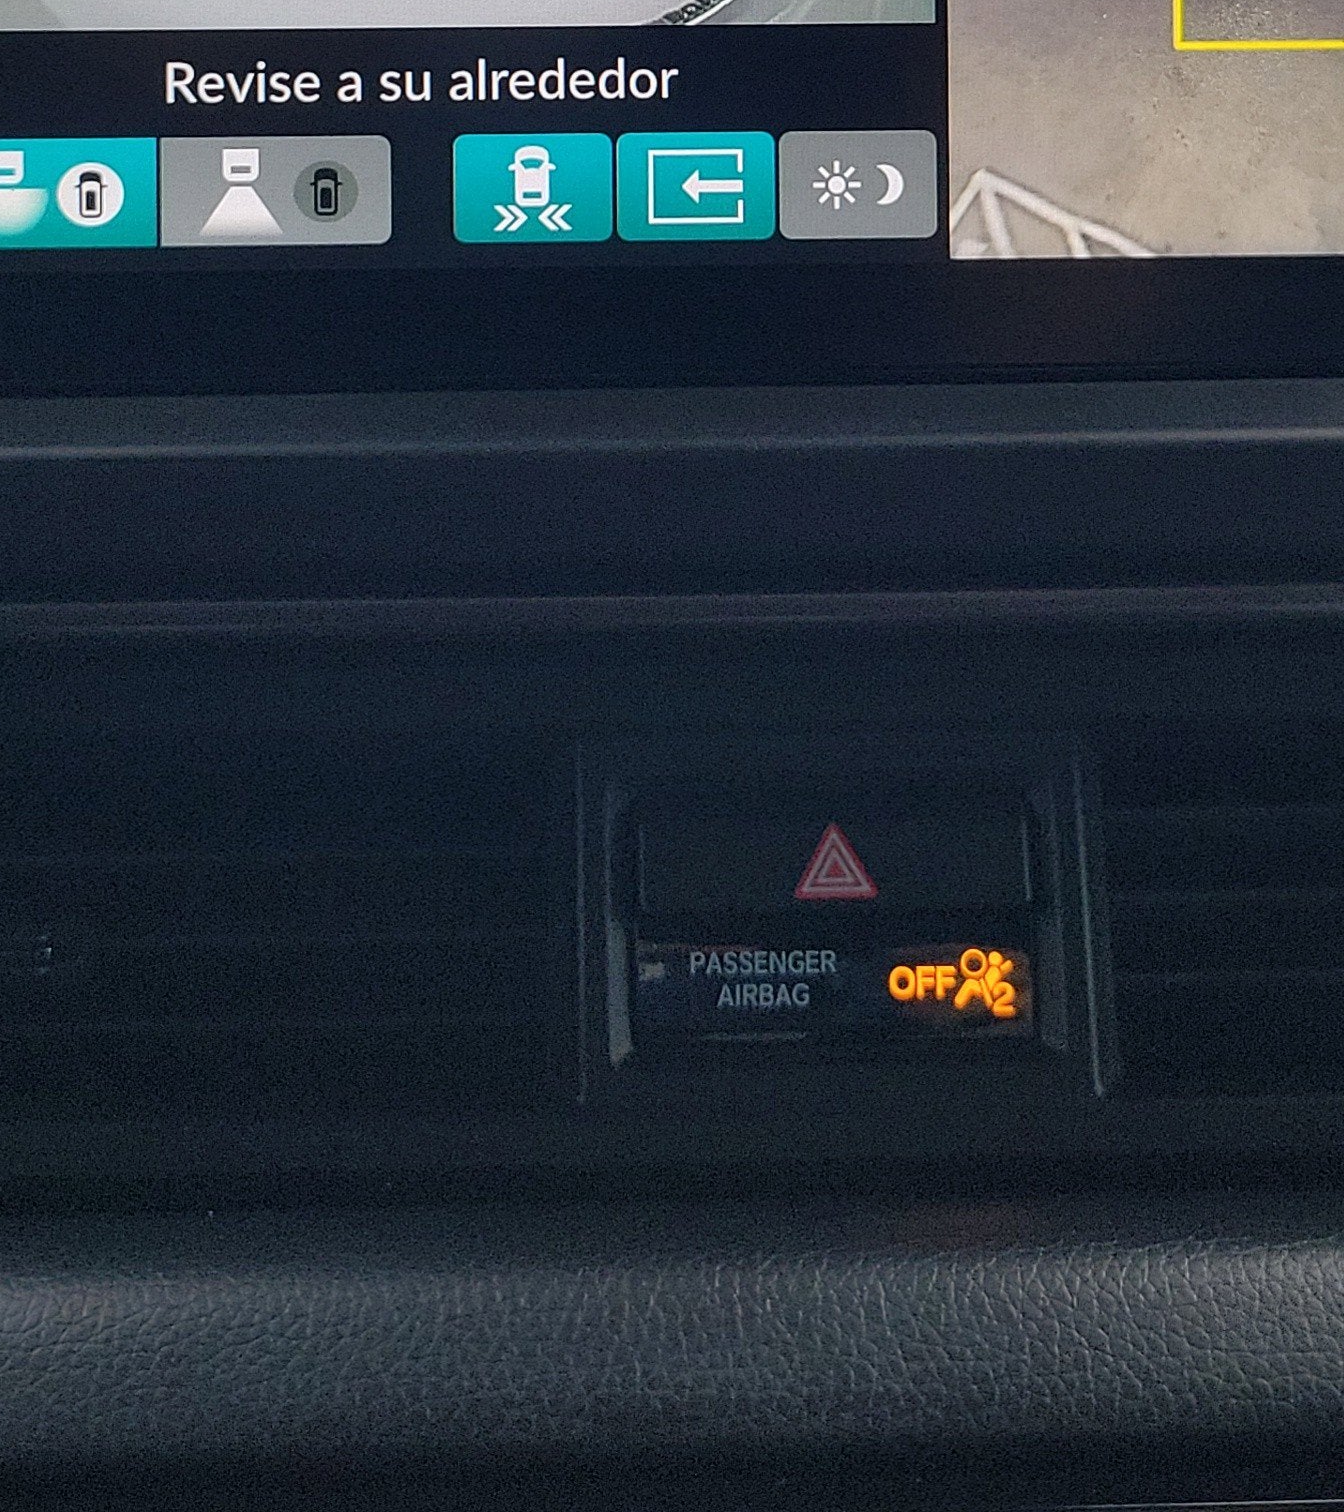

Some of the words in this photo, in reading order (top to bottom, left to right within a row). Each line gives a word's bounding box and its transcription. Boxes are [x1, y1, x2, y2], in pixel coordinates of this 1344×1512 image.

[164, 61, 321, 104] Revise
[337, 71, 363, 102] a
[378, 68, 431, 102] su
[448, 56, 680, 101] alrededor
[689, 950, 837, 974] PASSENGER
[716, 983, 810, 1007] AIRBAG
[888, 964, 956, 1000] OFF
